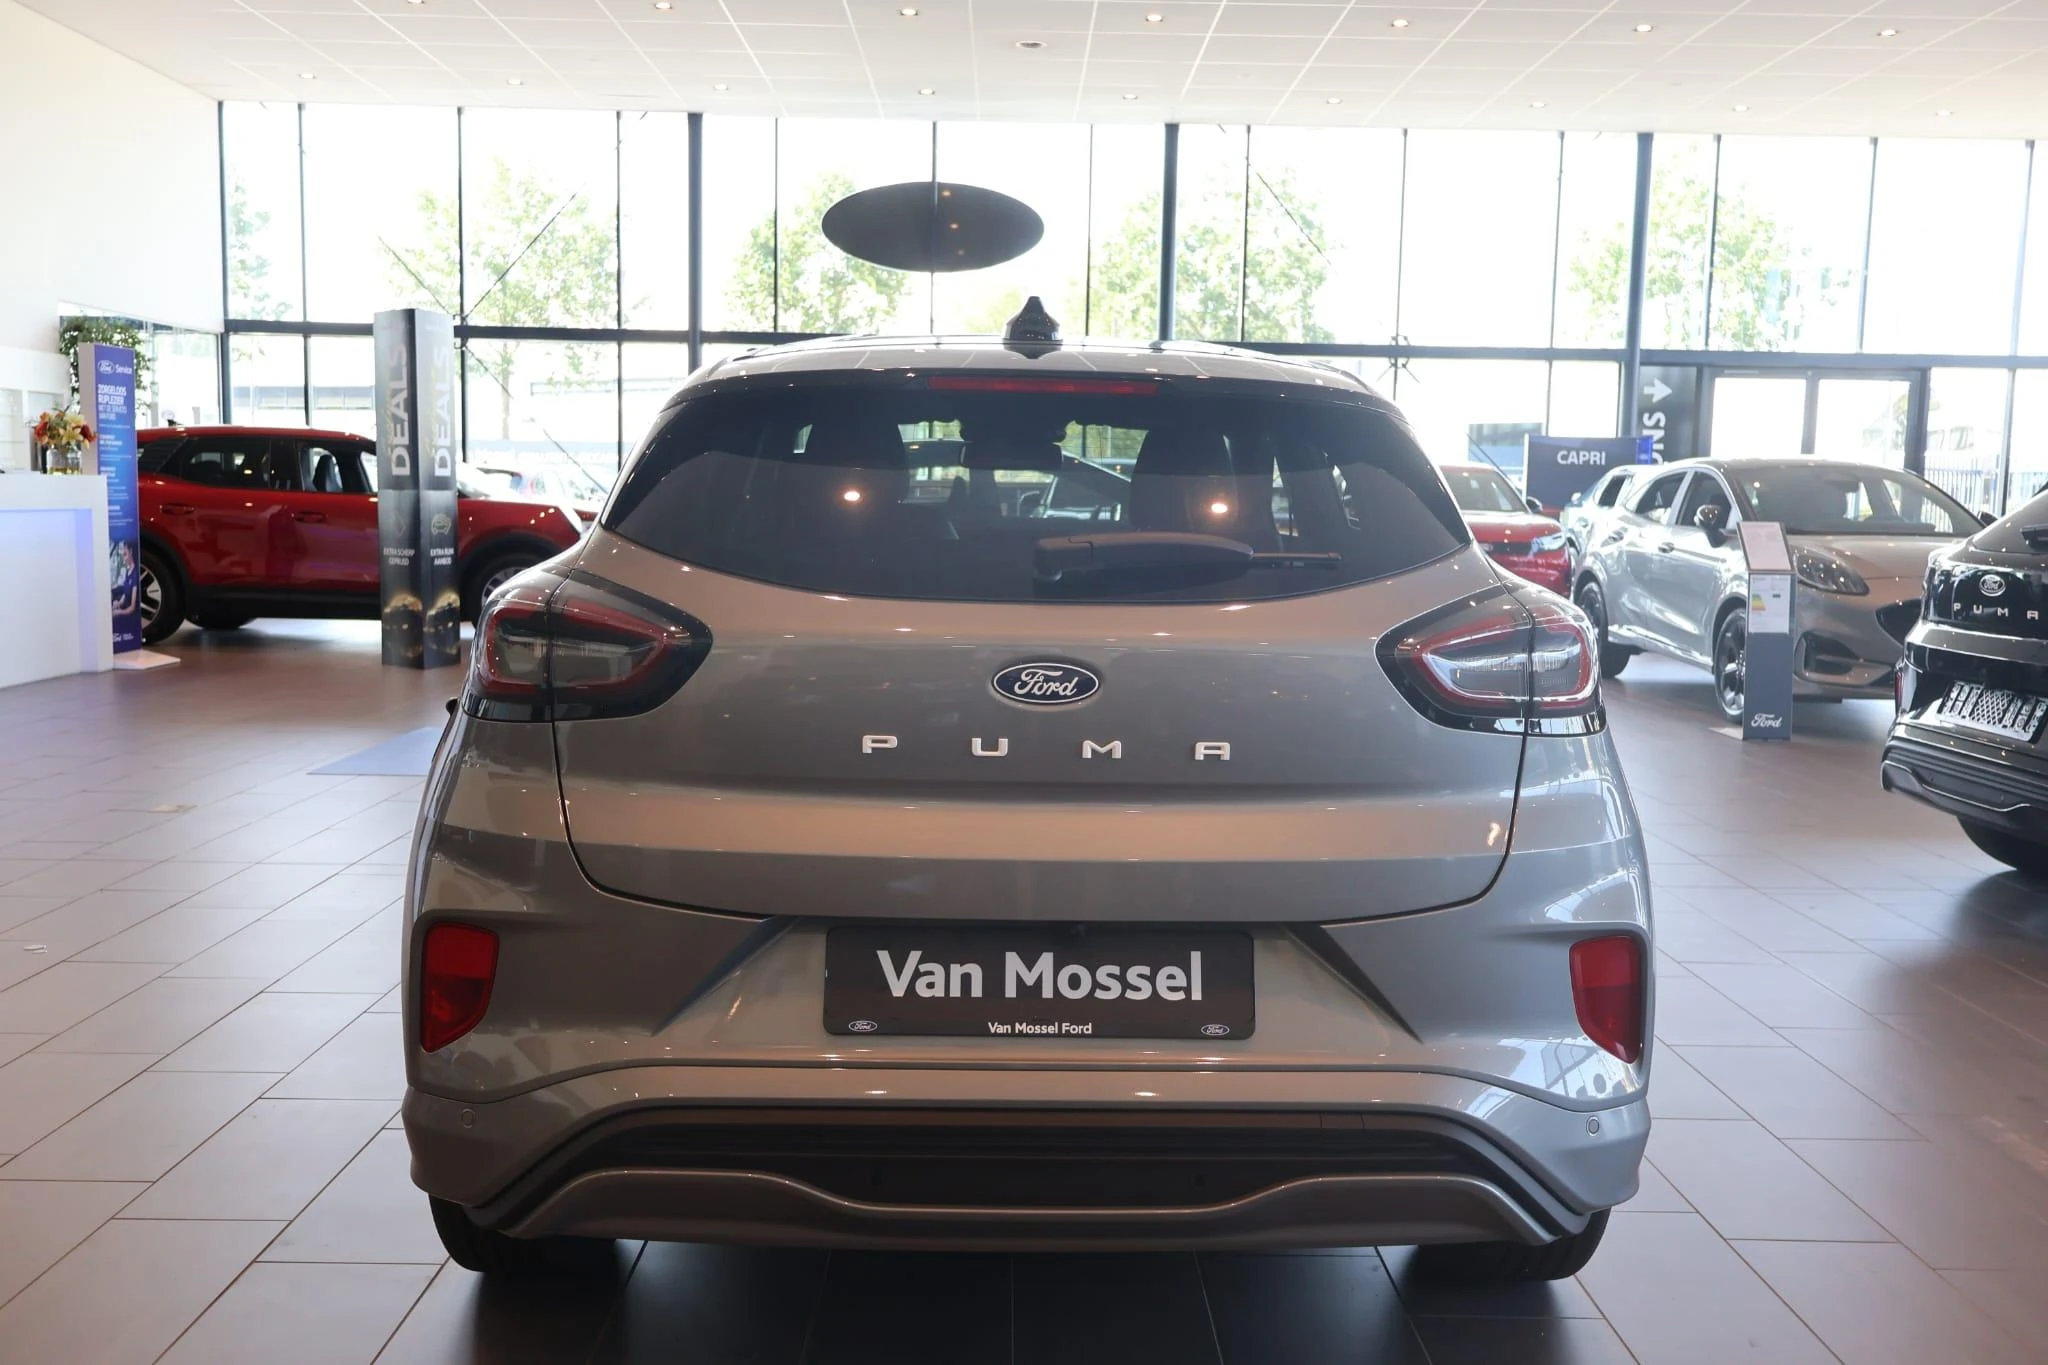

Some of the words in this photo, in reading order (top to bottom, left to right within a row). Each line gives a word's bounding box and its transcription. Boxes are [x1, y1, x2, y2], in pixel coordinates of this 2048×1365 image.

[388, 344, 410, 476] DEALS
[435, 347, 451, 477] DEALS
[1556, 450, 1606, 465] CAPRI
[1953, 603, 2039, 621] PUMA
[1013, 668, 1078, 696] Ford
[1751, 713, 1783, 728] Ford
[862, 735, 1231, 761] PUMA
[876, 950, 983, 998] Van
[1004, 951, 1202, 1001] Mossel
[988, 1022, 1012, 1033] Van
[1015, 1022, 1059, 1034] Mossel
[1062, 1023, 1092, 1034] Ford
